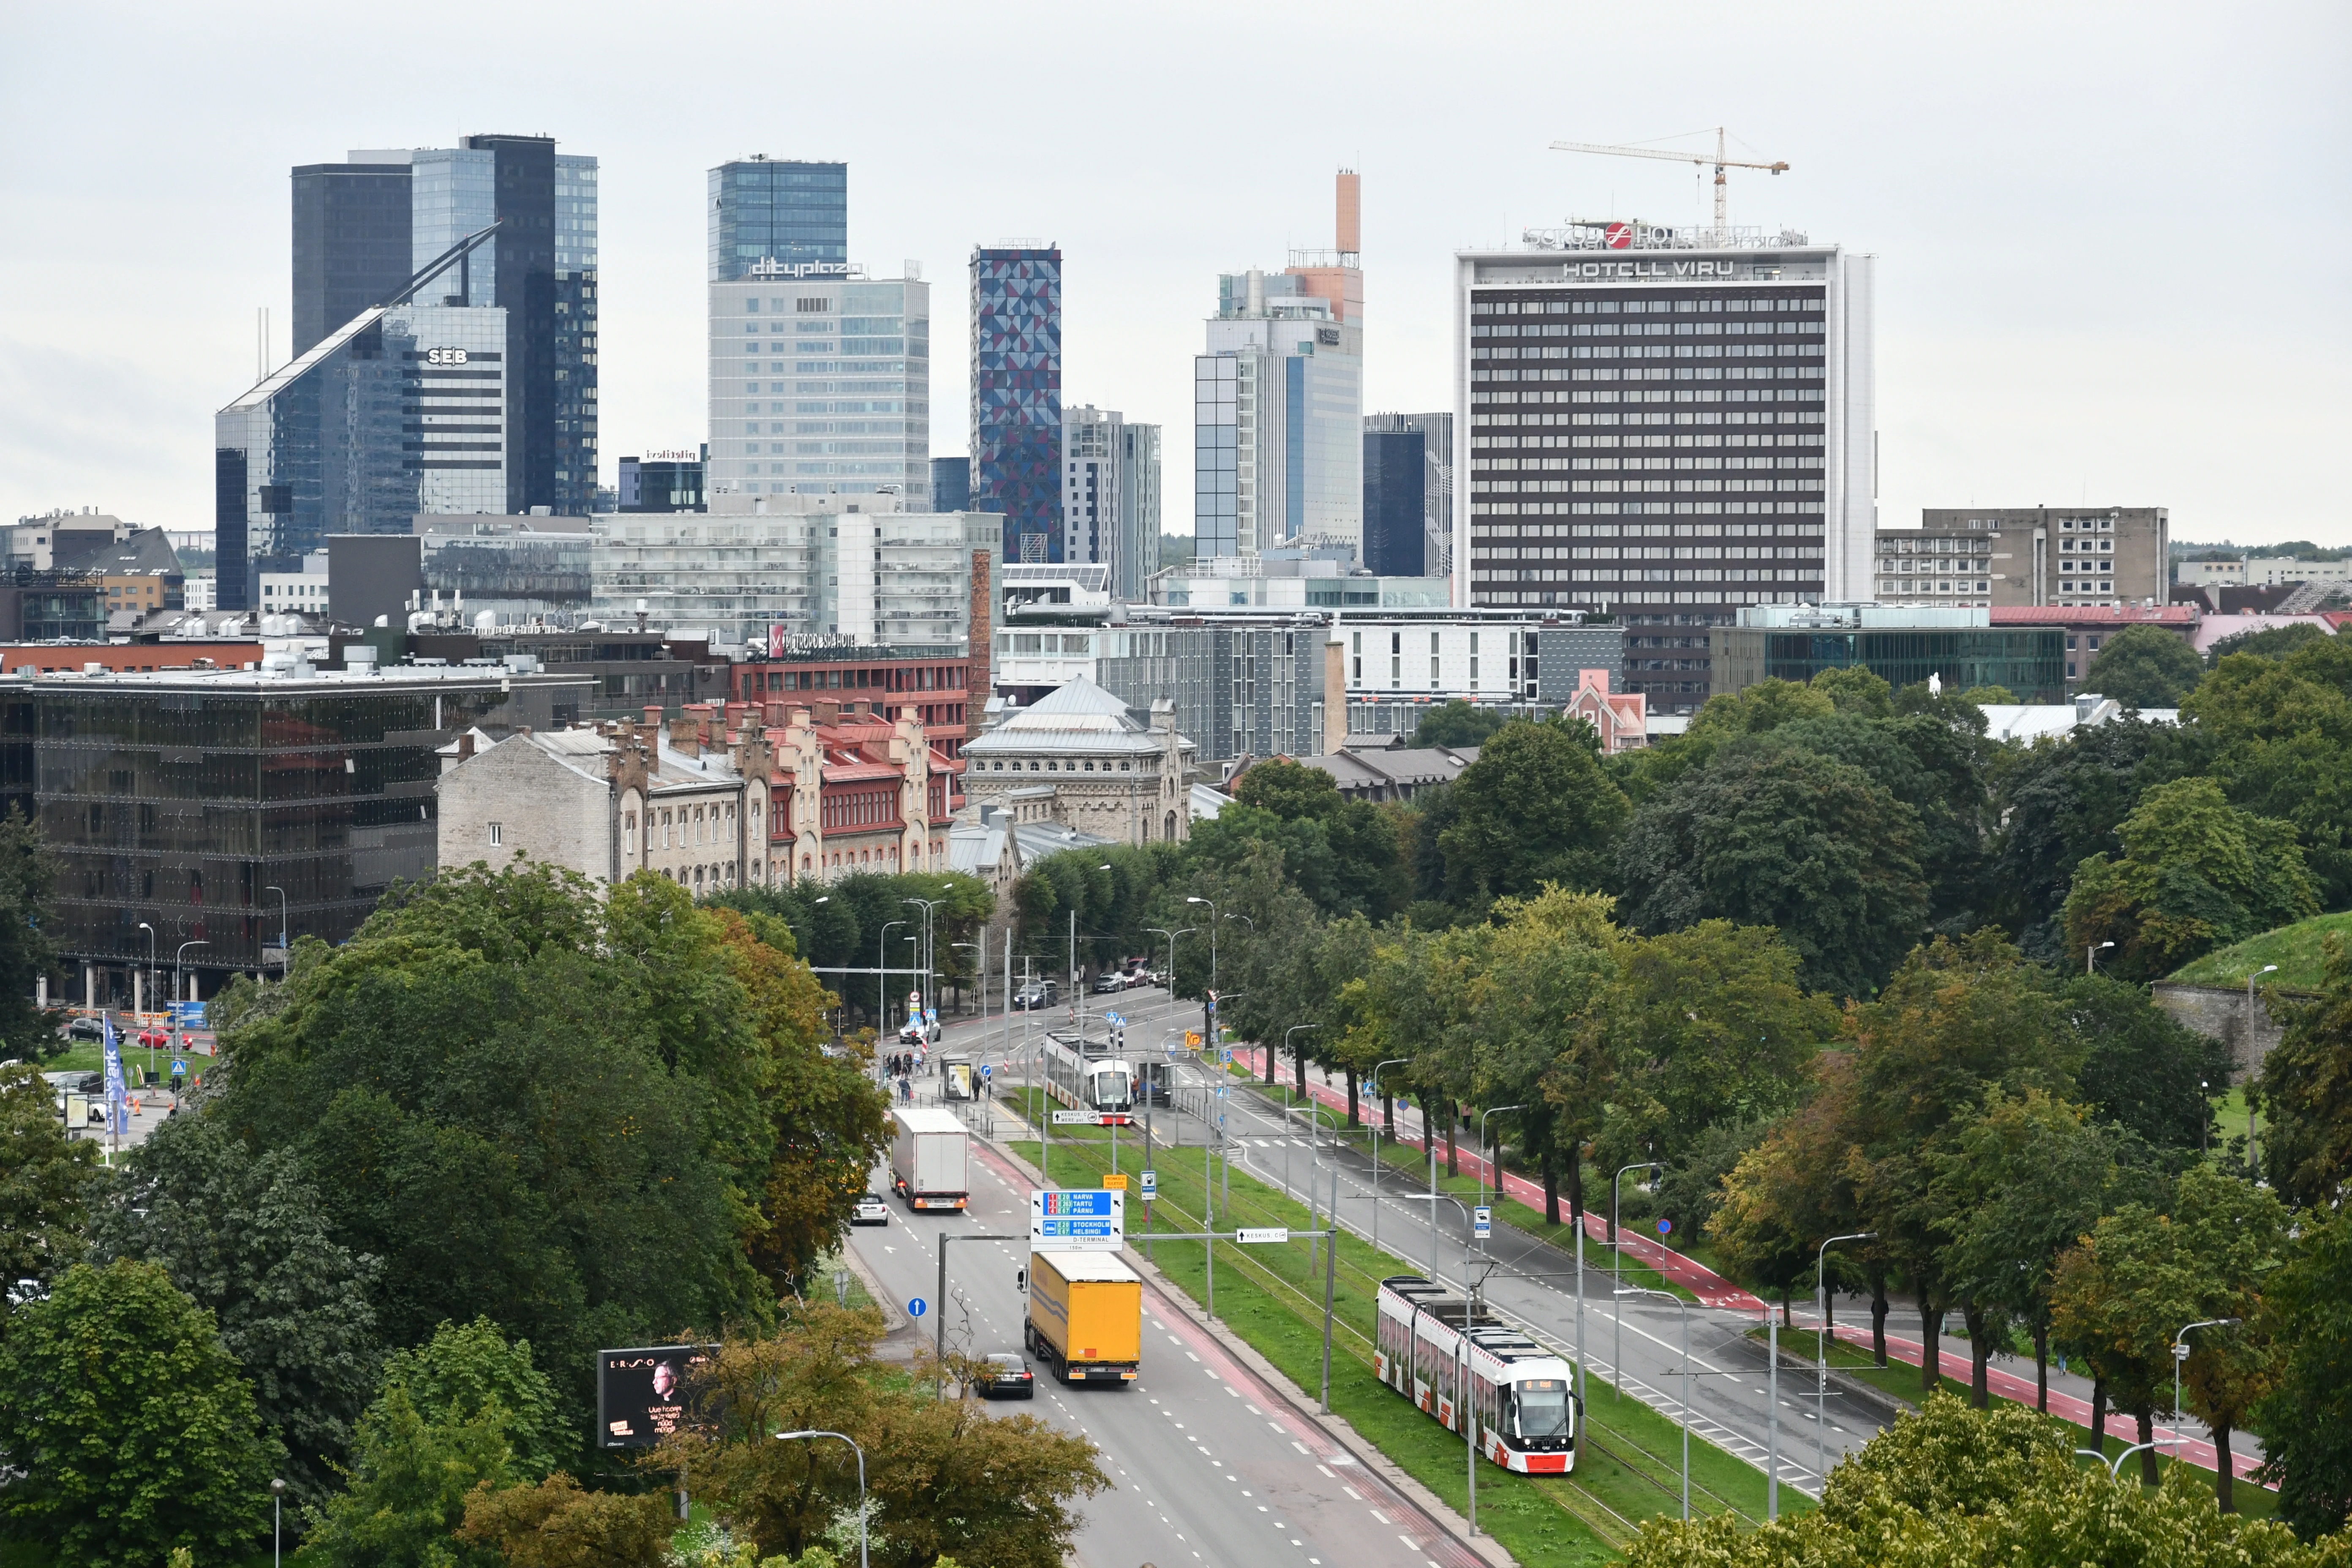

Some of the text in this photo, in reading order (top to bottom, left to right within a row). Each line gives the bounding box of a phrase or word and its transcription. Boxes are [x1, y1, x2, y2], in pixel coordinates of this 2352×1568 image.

[1527, 227, 1600, 245] SOKOS
[1563, 261, 1734, 277] HOTELL VIRU
[428, 349, 467, 363] SEB
[786, 634, 823, 649] METROPOL
[824, 634, 836, 648] SPA
[1526, 1380, 1532, 1389] 6
[612, 1422, 626, 1430] pileti
